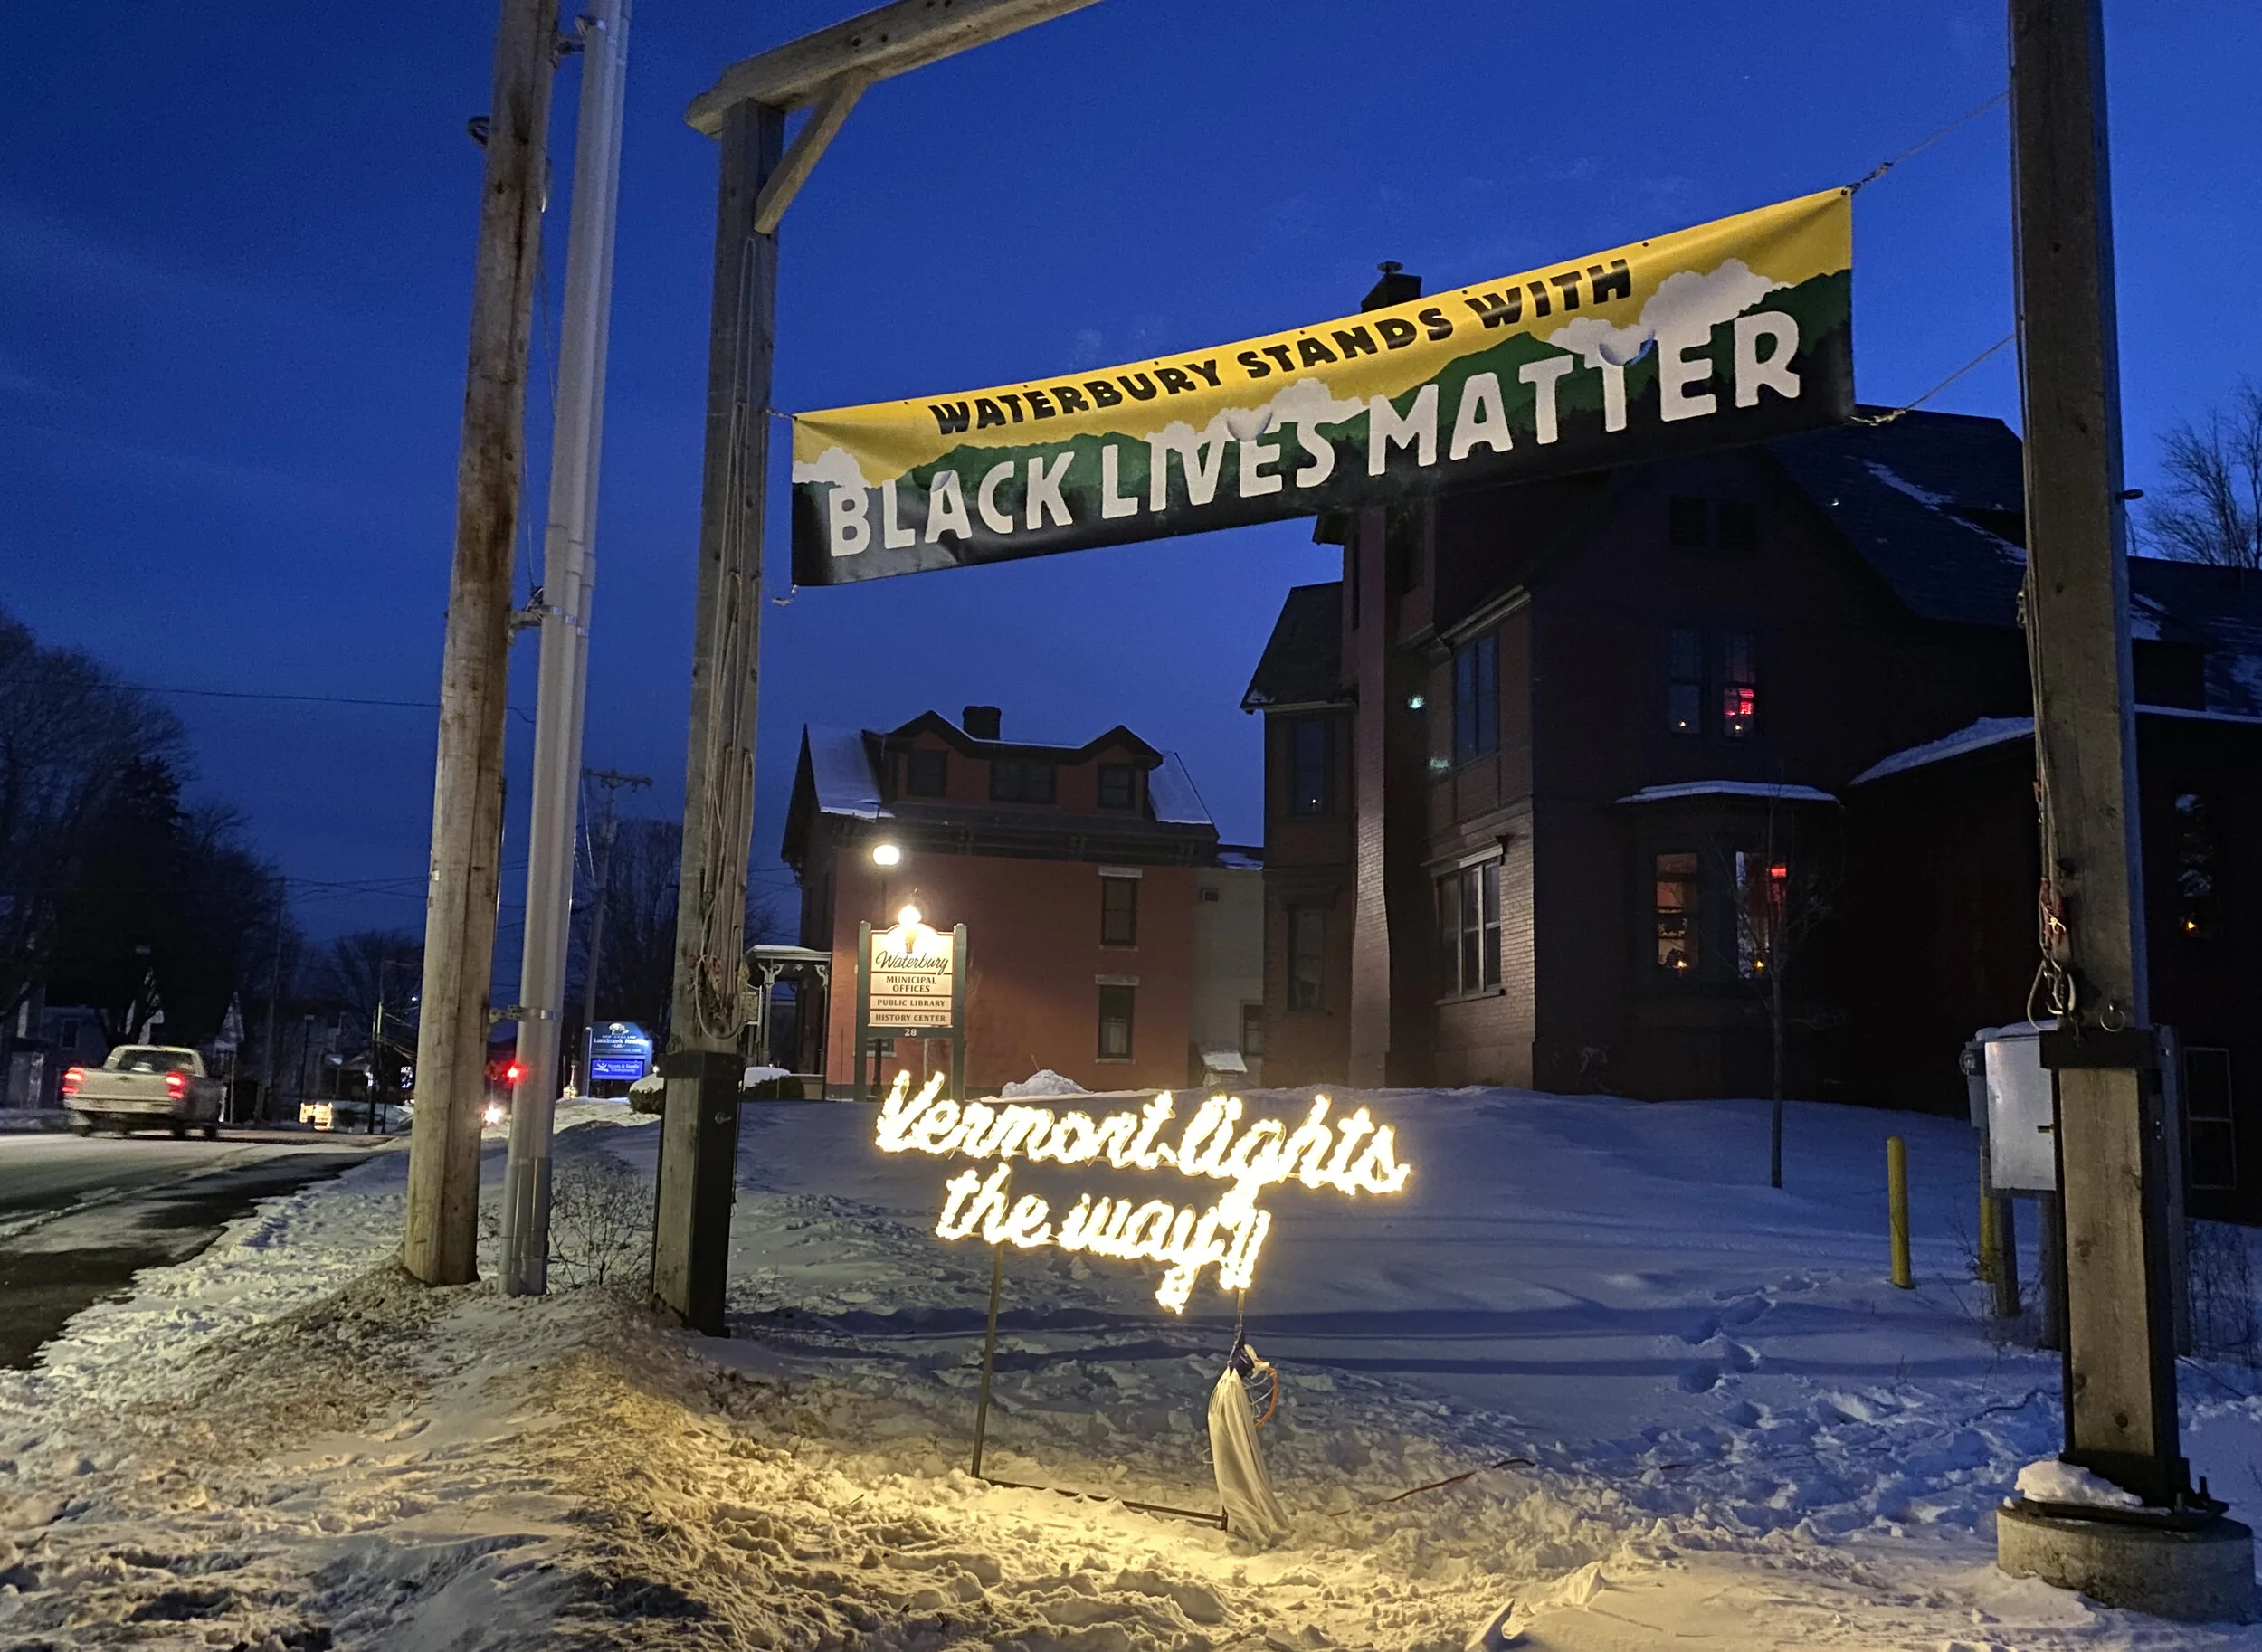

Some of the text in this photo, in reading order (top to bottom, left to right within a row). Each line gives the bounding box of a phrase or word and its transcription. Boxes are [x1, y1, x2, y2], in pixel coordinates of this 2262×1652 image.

[927, 258, 1631, 435] WATERBURY STANDS WITH
[829, 310, 1801, 558] BLACK LIVES MATTER
[875, 950, 949, 975] Waterbury
[886, 976, 937, 984] MUNICIPAL
[892, 984, 930, 992] OFFICES
[905, 1028, 917, 1037] 28
[875, 1069, 1411, 1229] Vermont lights
[935, 1162, 1053, 1248] the
